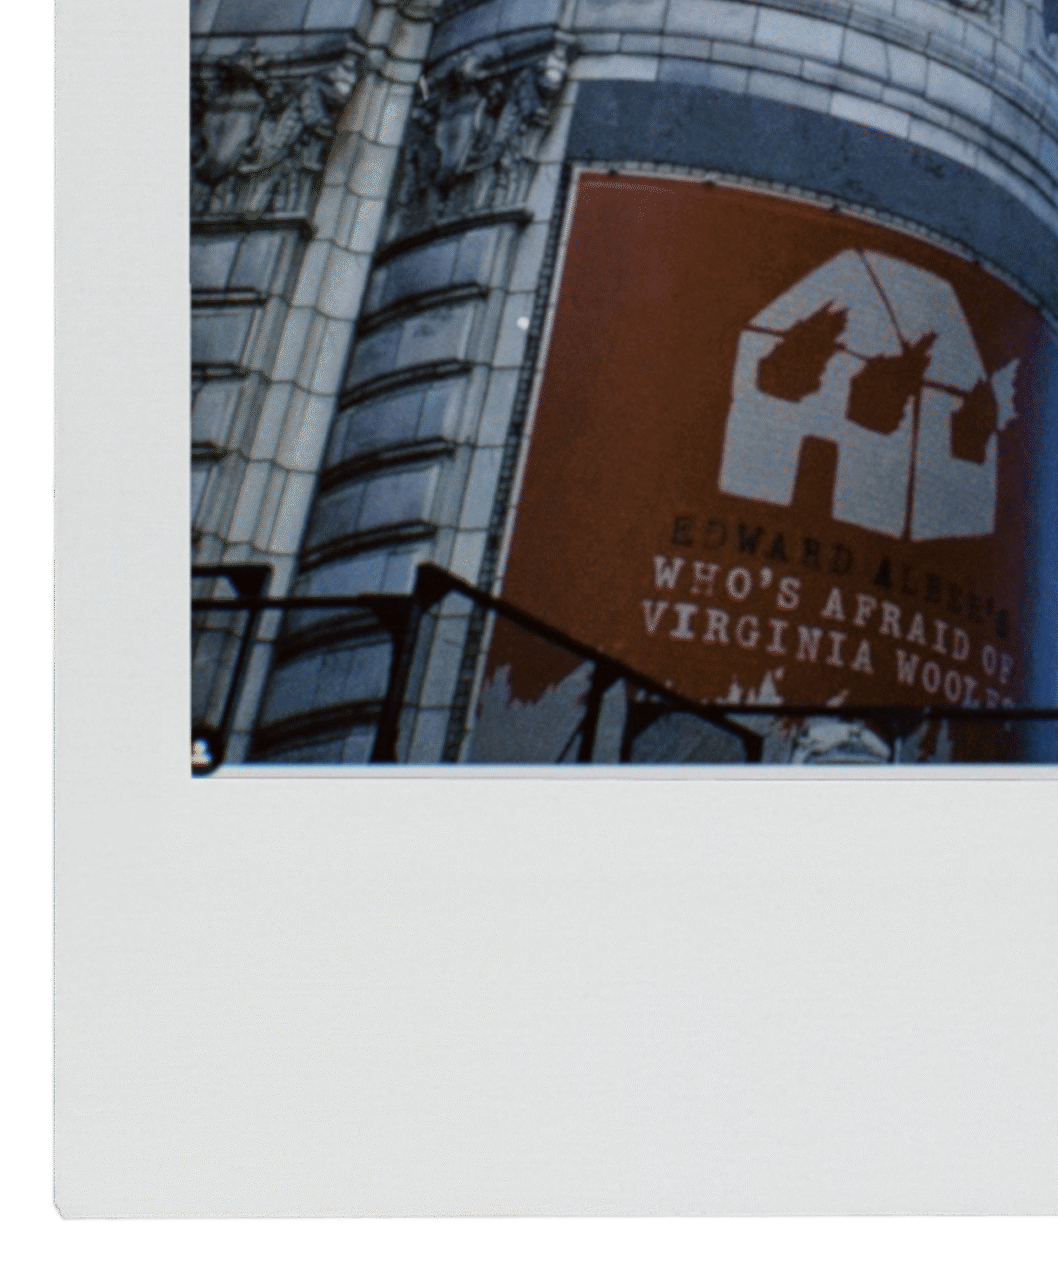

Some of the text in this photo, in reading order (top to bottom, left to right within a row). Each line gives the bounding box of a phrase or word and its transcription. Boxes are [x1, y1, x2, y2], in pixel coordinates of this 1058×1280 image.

[671, 517, 855, 576] EDWARD
[641, 599, 875, 674] VIRGINIA
[652, 554, 1015, 686] WHO'S AFRAID OF
